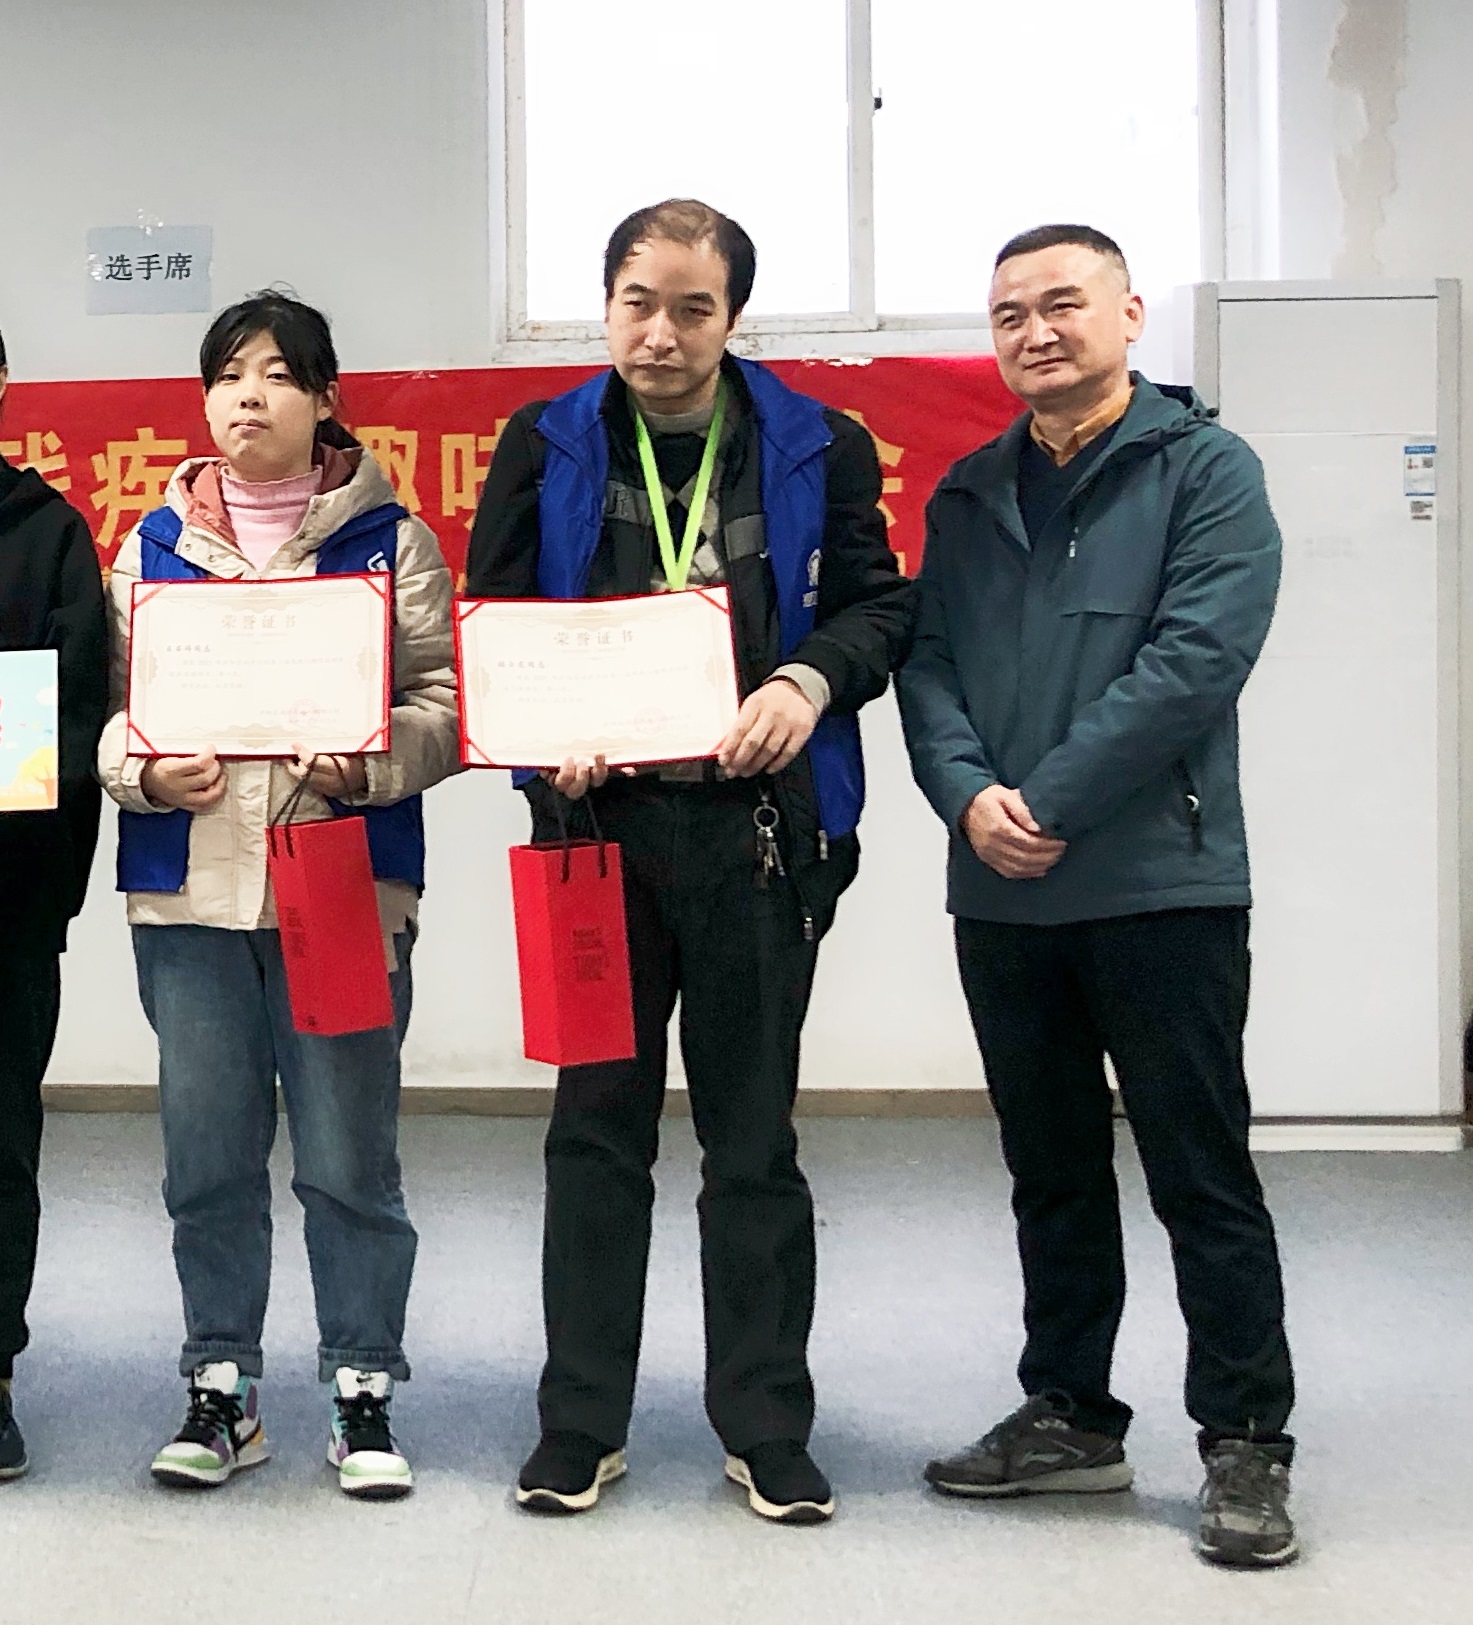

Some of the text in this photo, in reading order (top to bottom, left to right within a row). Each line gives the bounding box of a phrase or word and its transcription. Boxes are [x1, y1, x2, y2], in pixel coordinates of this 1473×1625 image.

[105, 252, 192, 280] 选手席
[221, 613, 298, 631] 荣誉证书
[553, 629, 635, 647] 荣誉证书
